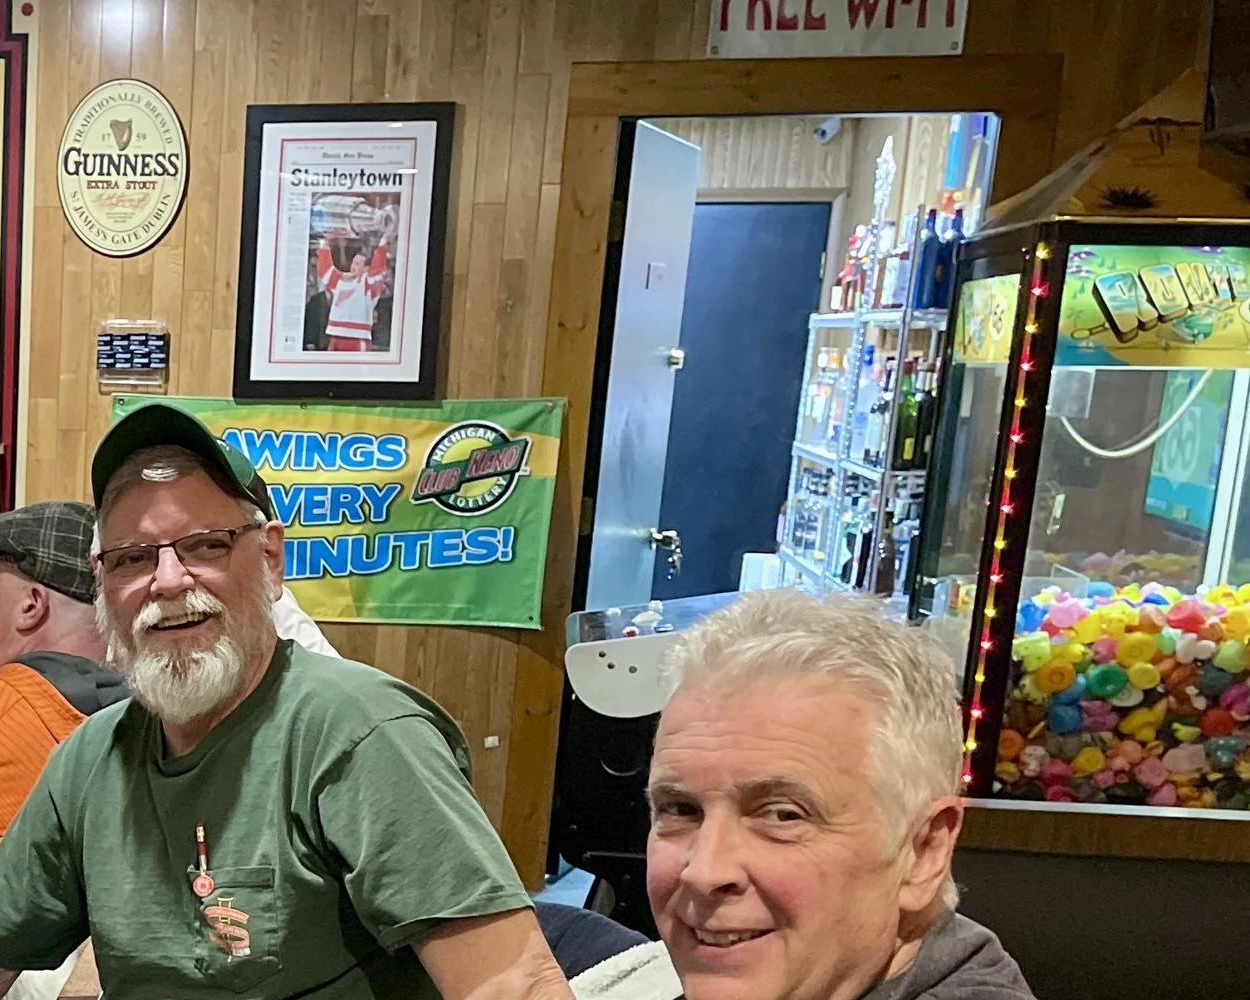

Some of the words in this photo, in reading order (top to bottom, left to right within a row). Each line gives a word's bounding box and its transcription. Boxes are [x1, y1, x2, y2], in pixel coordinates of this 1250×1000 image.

[144, 100, 174, 145] BREWED
[63, 147, 180, 177] GUINNESS
[290, 167, 403, 190] Stanleytown
[86, 180, 120, 190] EXTRA
[125, 180, 158, 190] STOUT
[111, 231, 142, 245] GATE
[143, 194, 172, 237] DUBLIN
[431, 427, 496, 461] MICHIGAN
[418, 467, 461, 495] CLUB
[465, 445, 519, 479] KENO
[448, 476, 507, 508] LOTTERY
